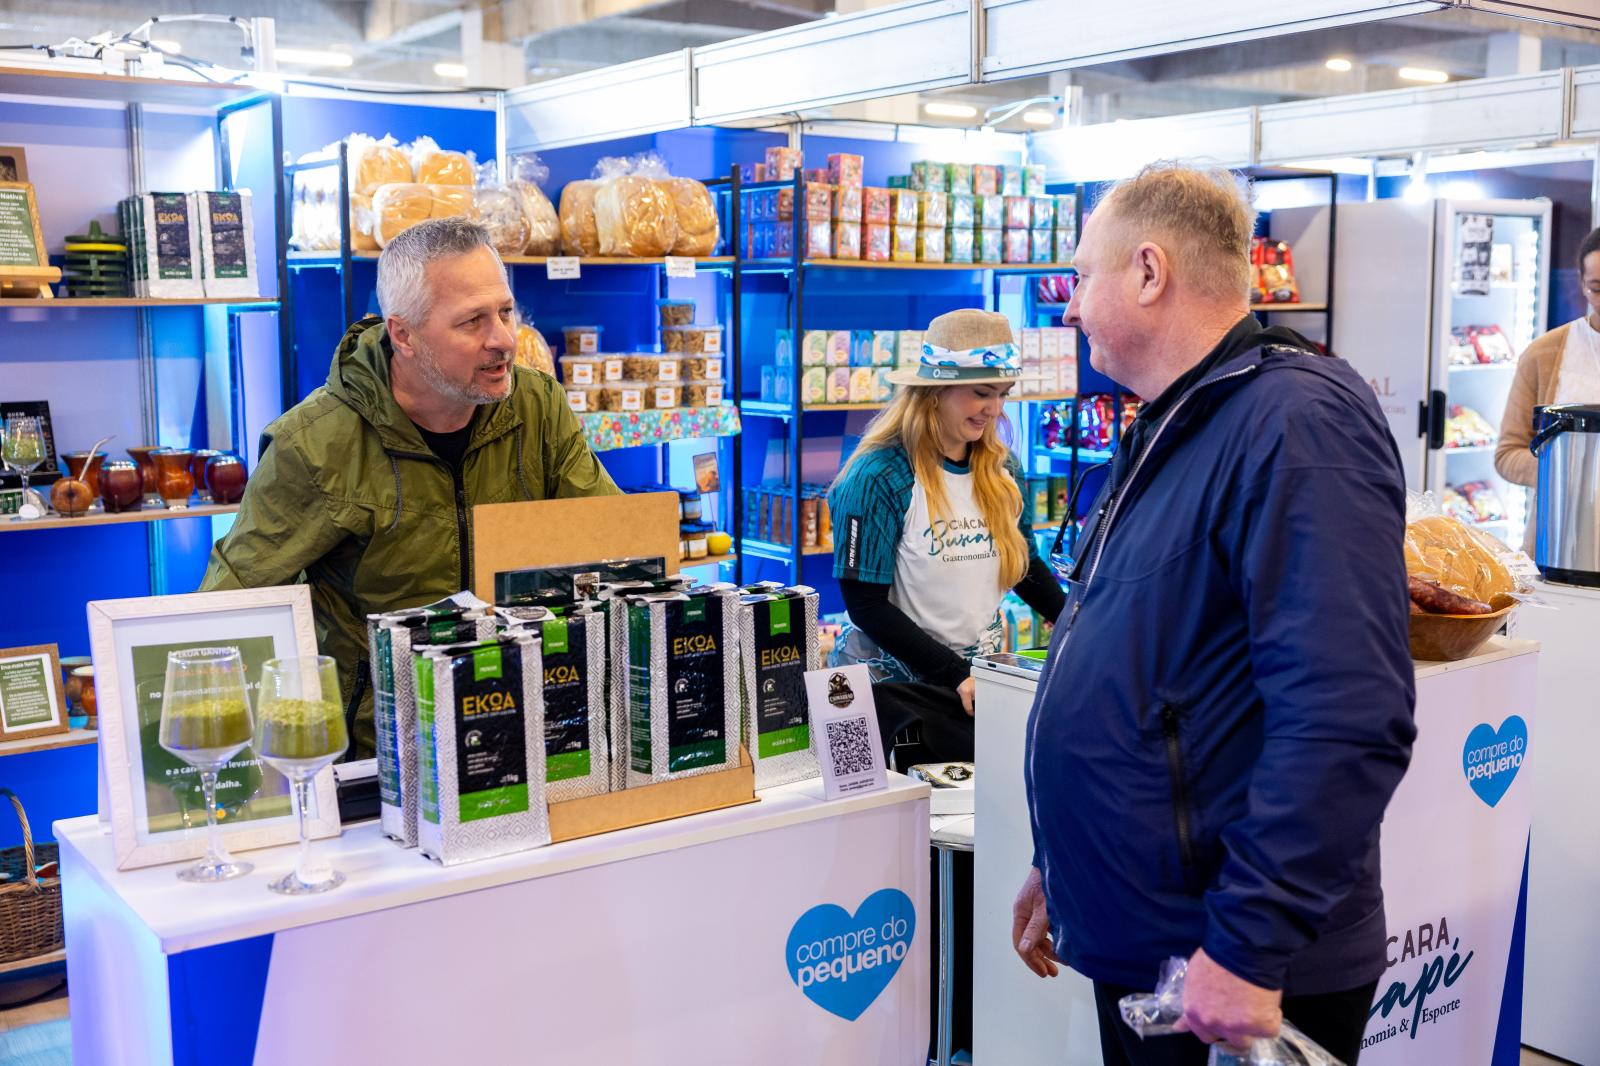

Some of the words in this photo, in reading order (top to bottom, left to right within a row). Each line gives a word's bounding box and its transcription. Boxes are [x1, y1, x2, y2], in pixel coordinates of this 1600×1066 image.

[1370, 376, 1397, 396] AL
[949, 517, 987, 530] CHÁCA
[942, 551, 990, 562] Gastronomia
[673, 634, 717, 655] EKOA
[761, 645, 800, 666] EKOA
[544, 665, 579, 684] KOA
[463, 691, 516, 715] EKOA
[1467, 741, 1508, 764] compre
[1509, 735, 1524, 752] do
[1468, 753, 1522, 783] pequeno
[796, 927, 876, 963] compre
[881, 916, 908, 940] do
[1385, 916, 1450, 968] CARA
[796, 941, 908, 991] pequeno
[1367, 936, 1474, 1040] apé
[1360, 1023, 1397, 1050] nomia
[1399, 1018, 1410, 1033] &
[1421, 999, 1461, 1024] Esporte
